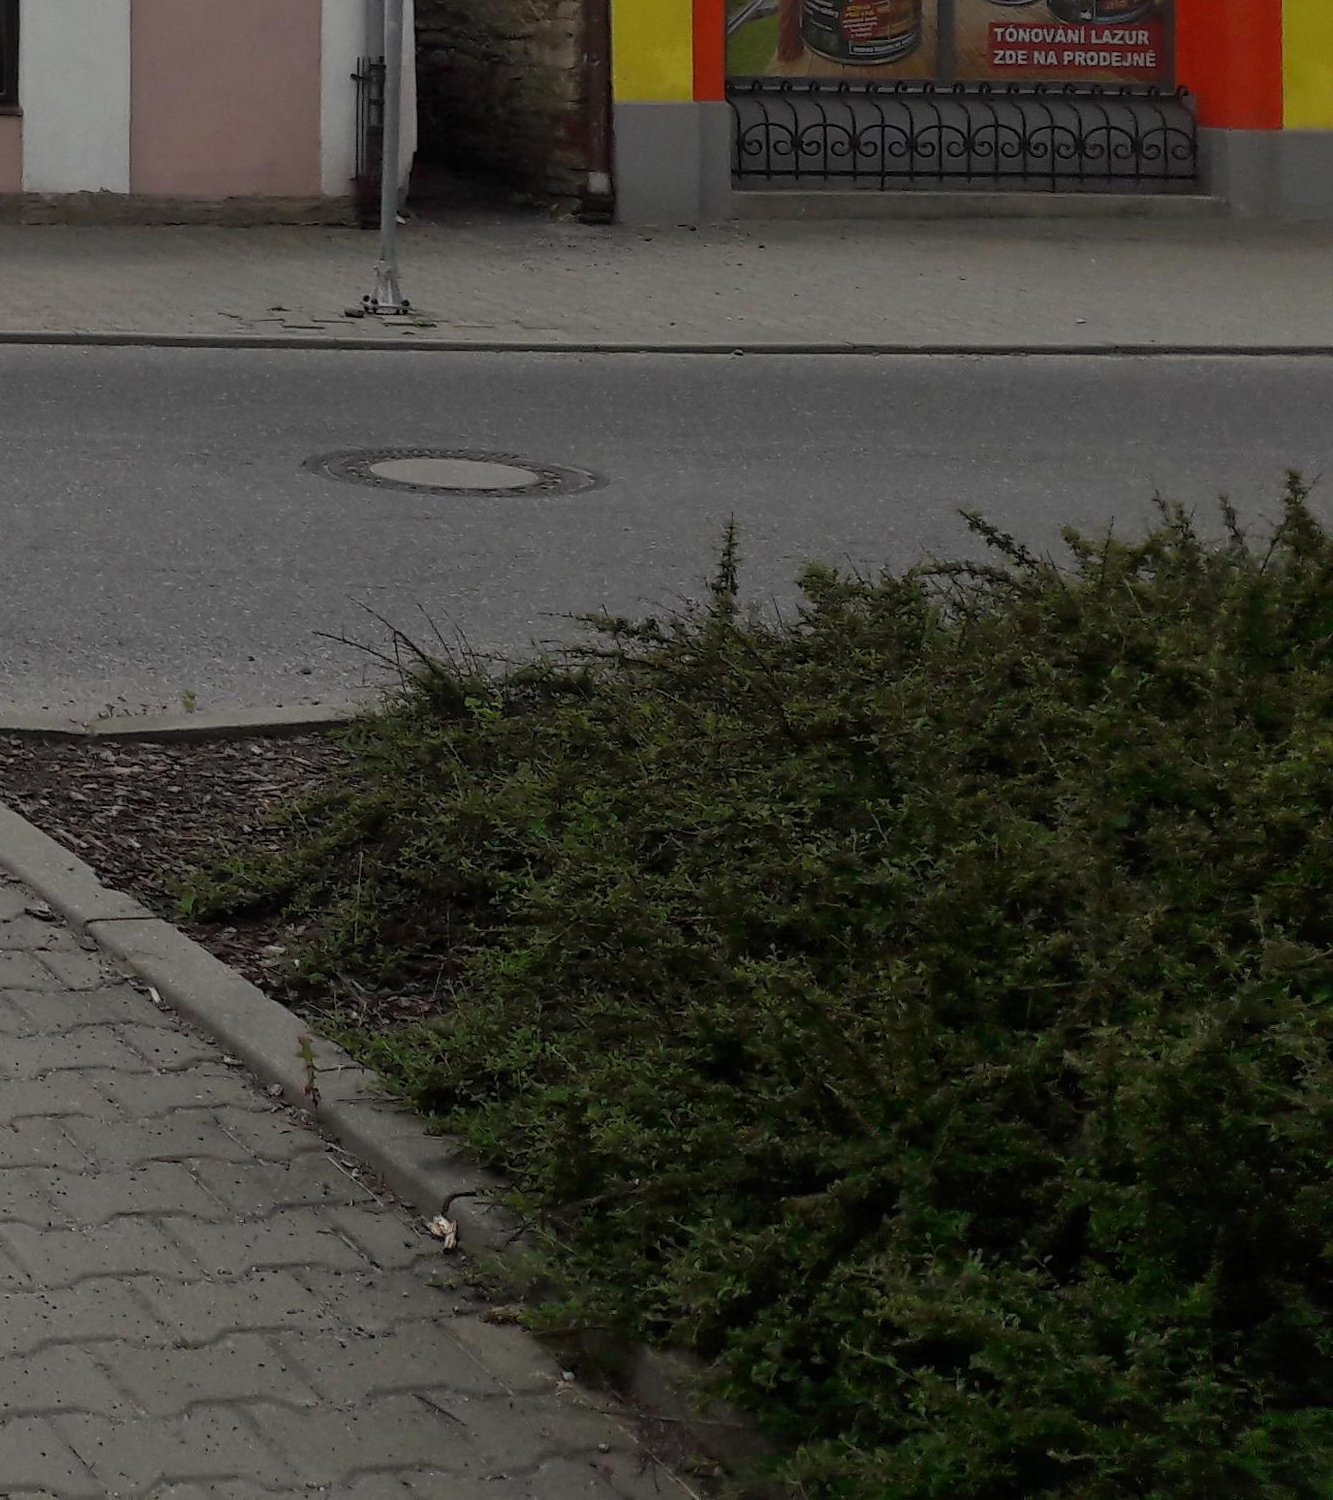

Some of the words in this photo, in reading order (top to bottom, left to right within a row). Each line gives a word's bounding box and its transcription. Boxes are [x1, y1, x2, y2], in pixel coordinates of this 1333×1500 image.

[993, 25, 1085, 44] TÓNOVÁNÍ
[1091, 30, 1150, 45] LAZUR
[993, 50, 1028, 65] ZDE
[1033, 51, 1059, 65] NA
[1063, 50, 1157, 67] PRODEJNĚ
